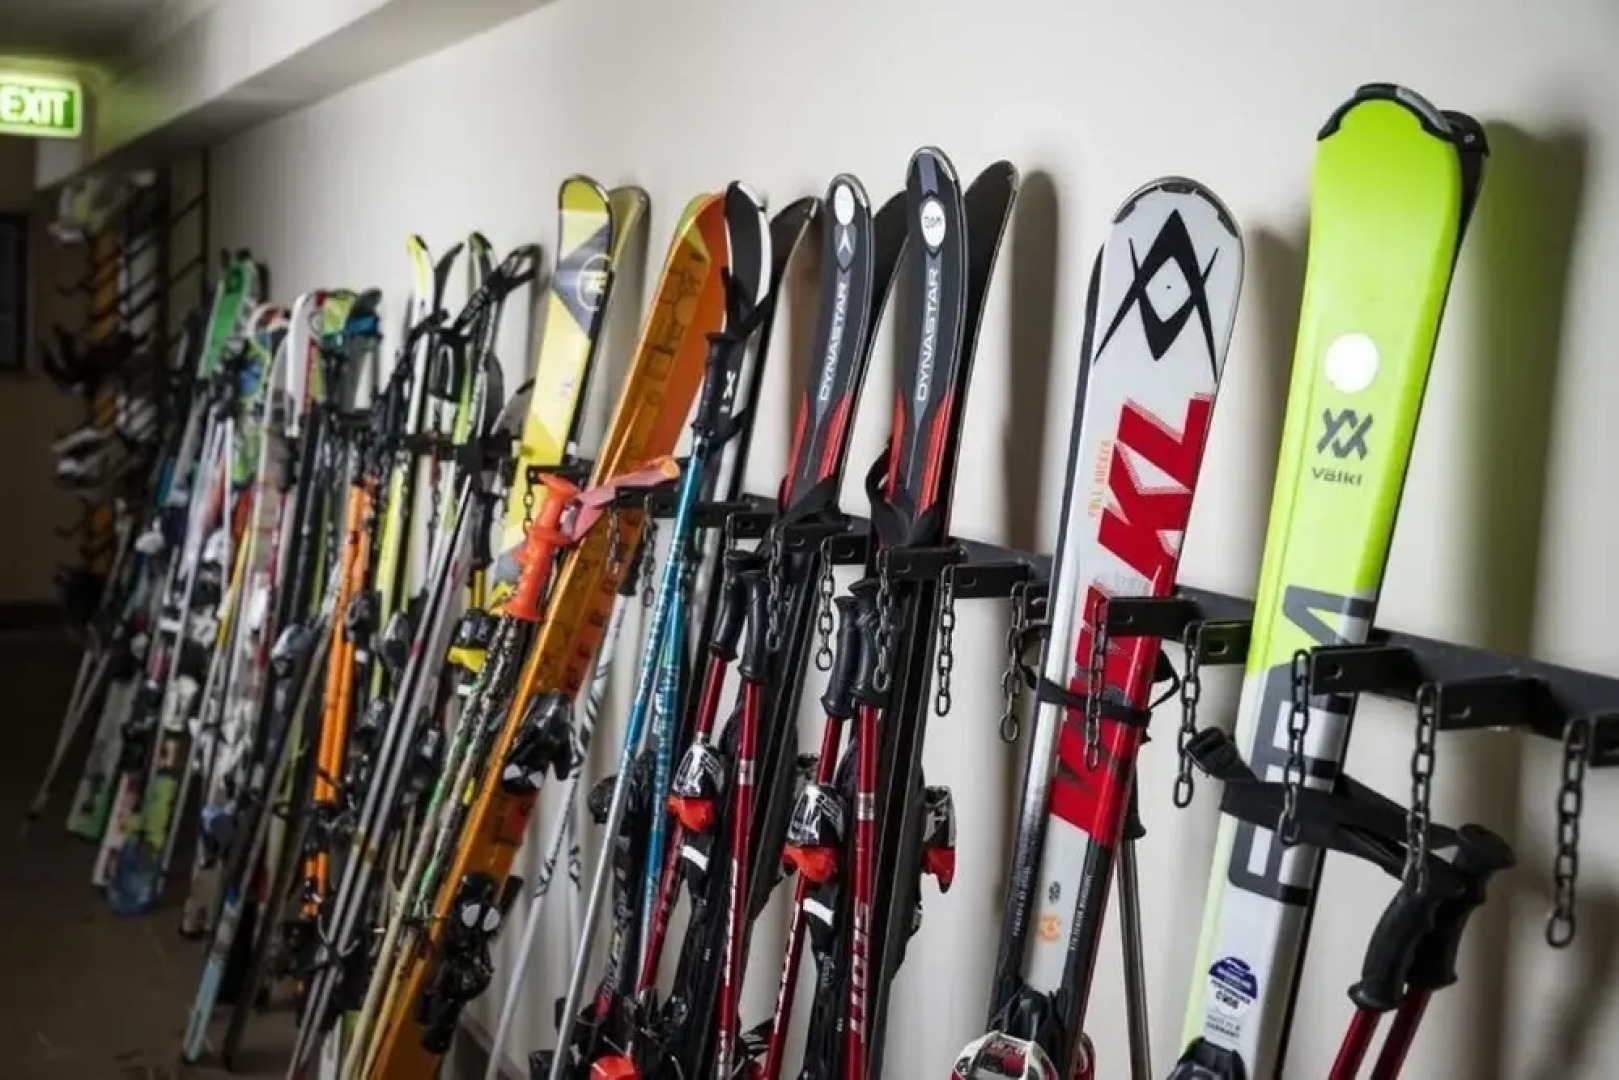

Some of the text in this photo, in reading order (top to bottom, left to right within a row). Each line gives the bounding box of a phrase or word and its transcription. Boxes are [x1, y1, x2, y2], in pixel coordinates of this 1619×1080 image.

[0, 86, 70, 126] EXIT
[820, 281, 848, 402] DYNASTAR
[917, 267, 938, 402] DYNASTAR
